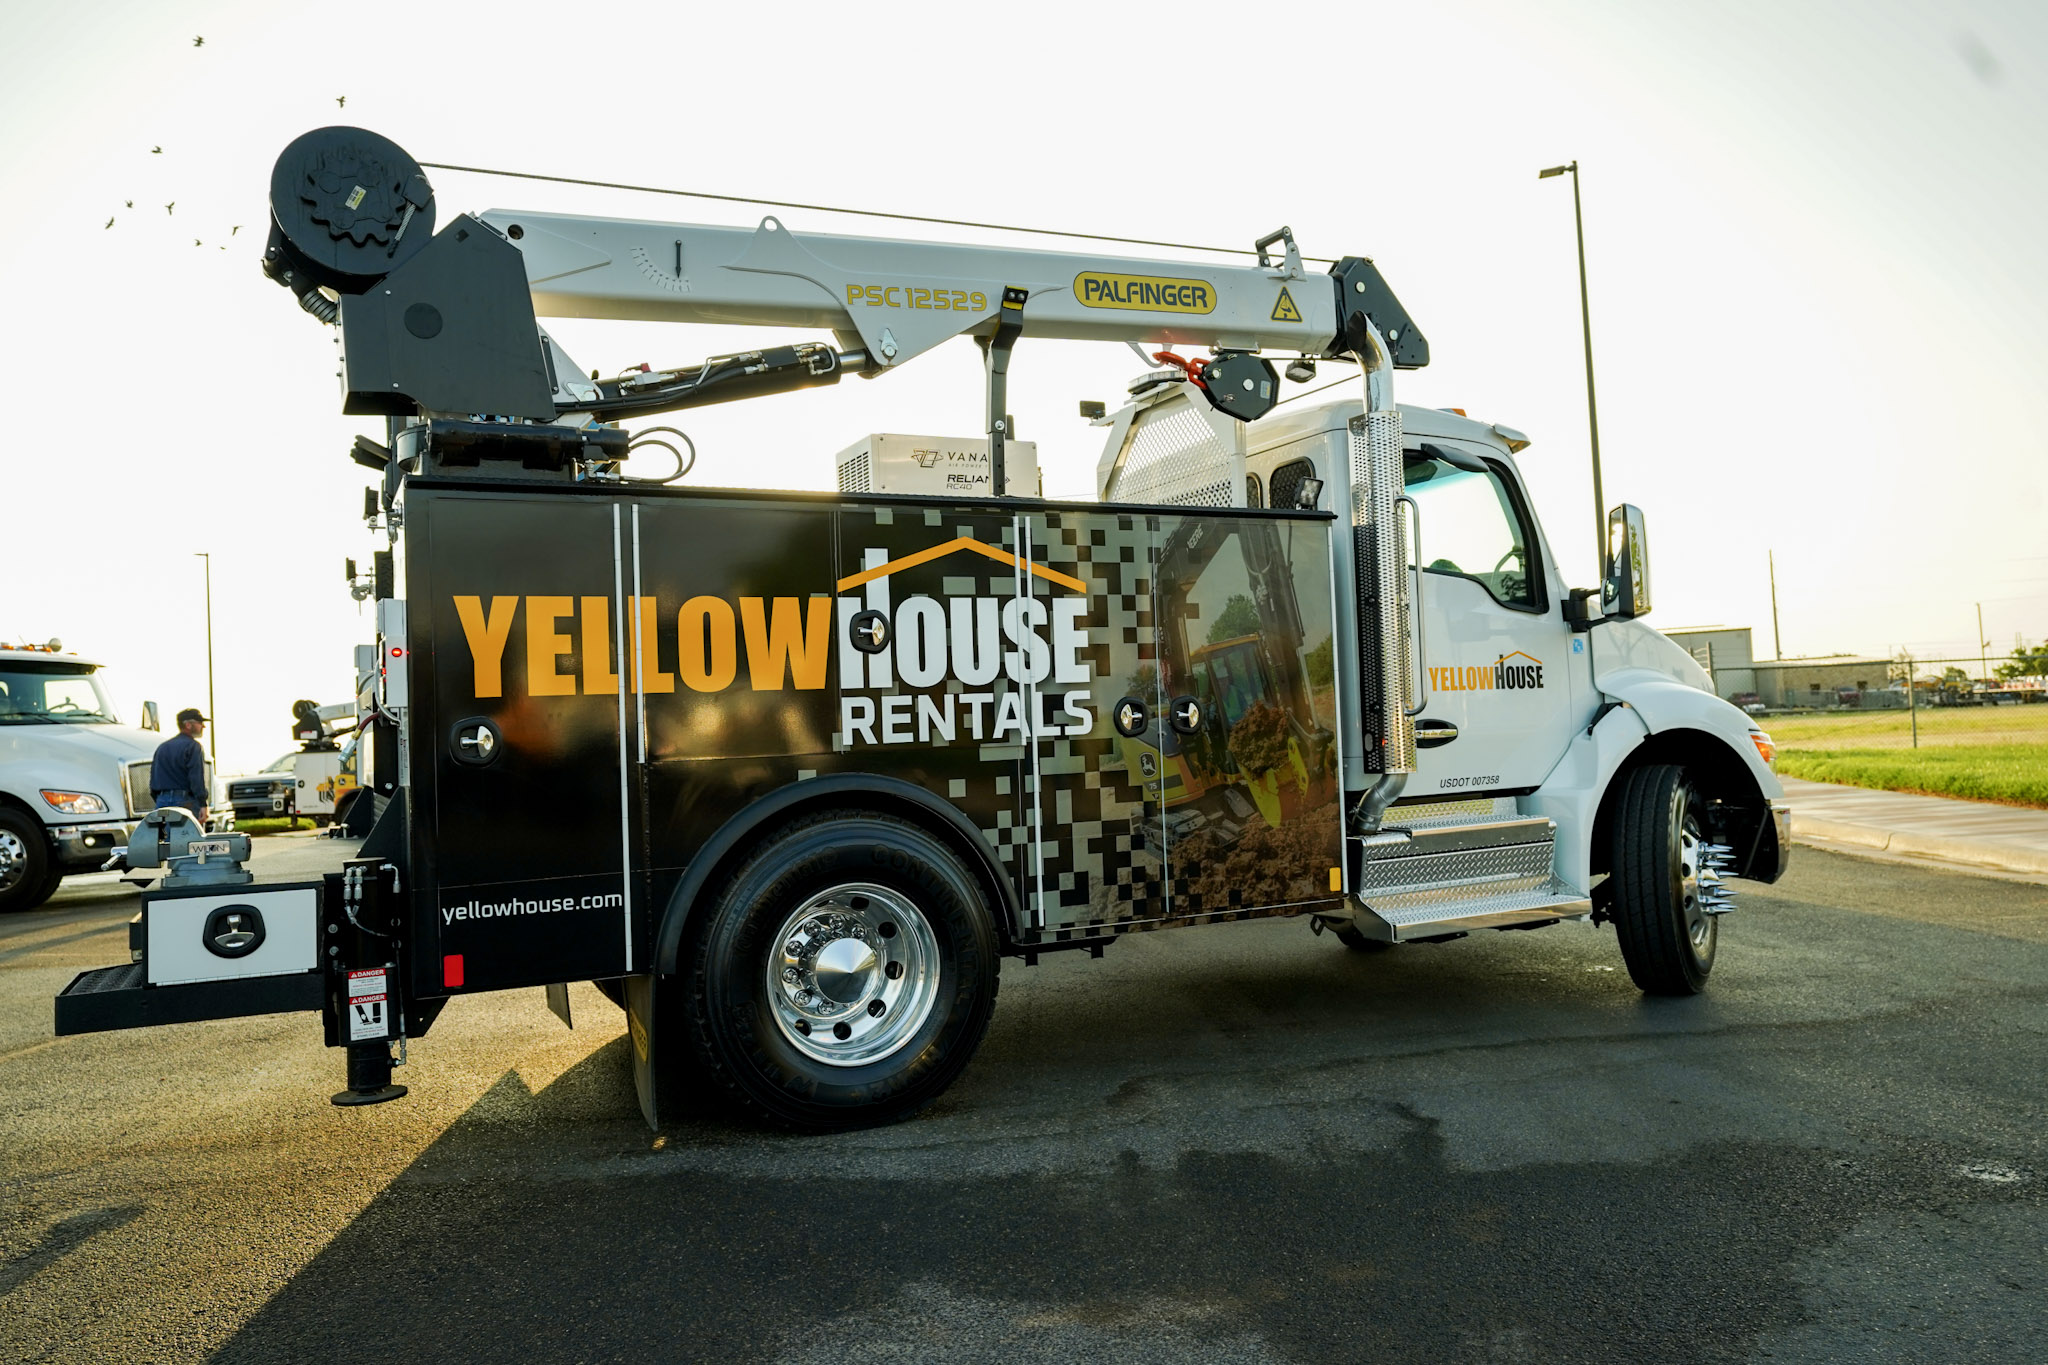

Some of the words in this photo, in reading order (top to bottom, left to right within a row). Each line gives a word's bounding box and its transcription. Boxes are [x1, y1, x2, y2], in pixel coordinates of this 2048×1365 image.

[846, 284, 901, 307] PSC
[905, 287, 987, 312] 12529
[1084, 278, 1208, 308] PALFINGER
[948, 451, 988, 463] VANA
[841, 690, 1093, 746] RENTALS
[1440, 777, 1471, 788] USDOT
[1471, 775, 1500, 786] 007358
[442, 893, 623, 926] yellowhouse.com
[357, 969, 384, 977] DANGER
[358, 995, 385, 1003] DANGER
